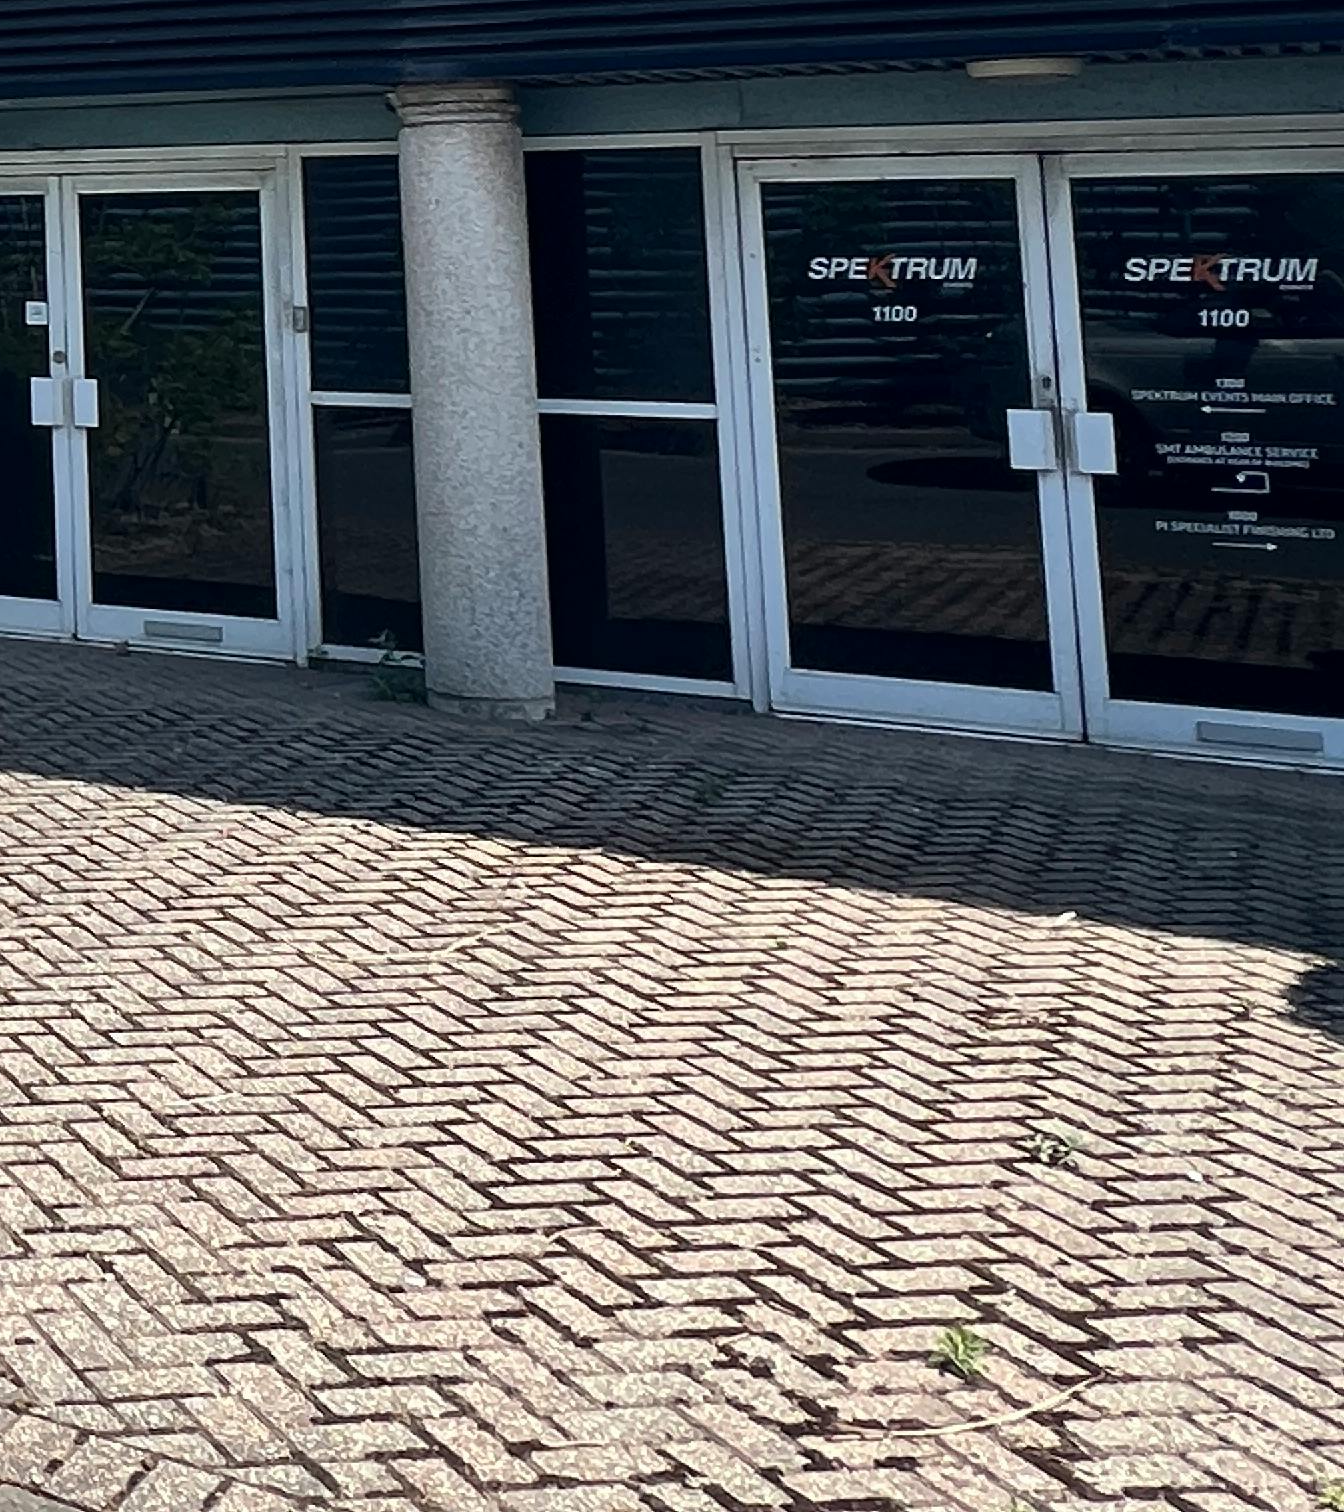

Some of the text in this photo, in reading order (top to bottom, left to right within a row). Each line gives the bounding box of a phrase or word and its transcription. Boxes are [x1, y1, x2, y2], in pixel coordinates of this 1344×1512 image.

[808, 253, 978, 287] SPEKTRUM
[1124, 253, 1318, 290] SPEKTRUM
[872, 305, 917, 322] 1100
[1198, 309, 1249, 328] 1100
